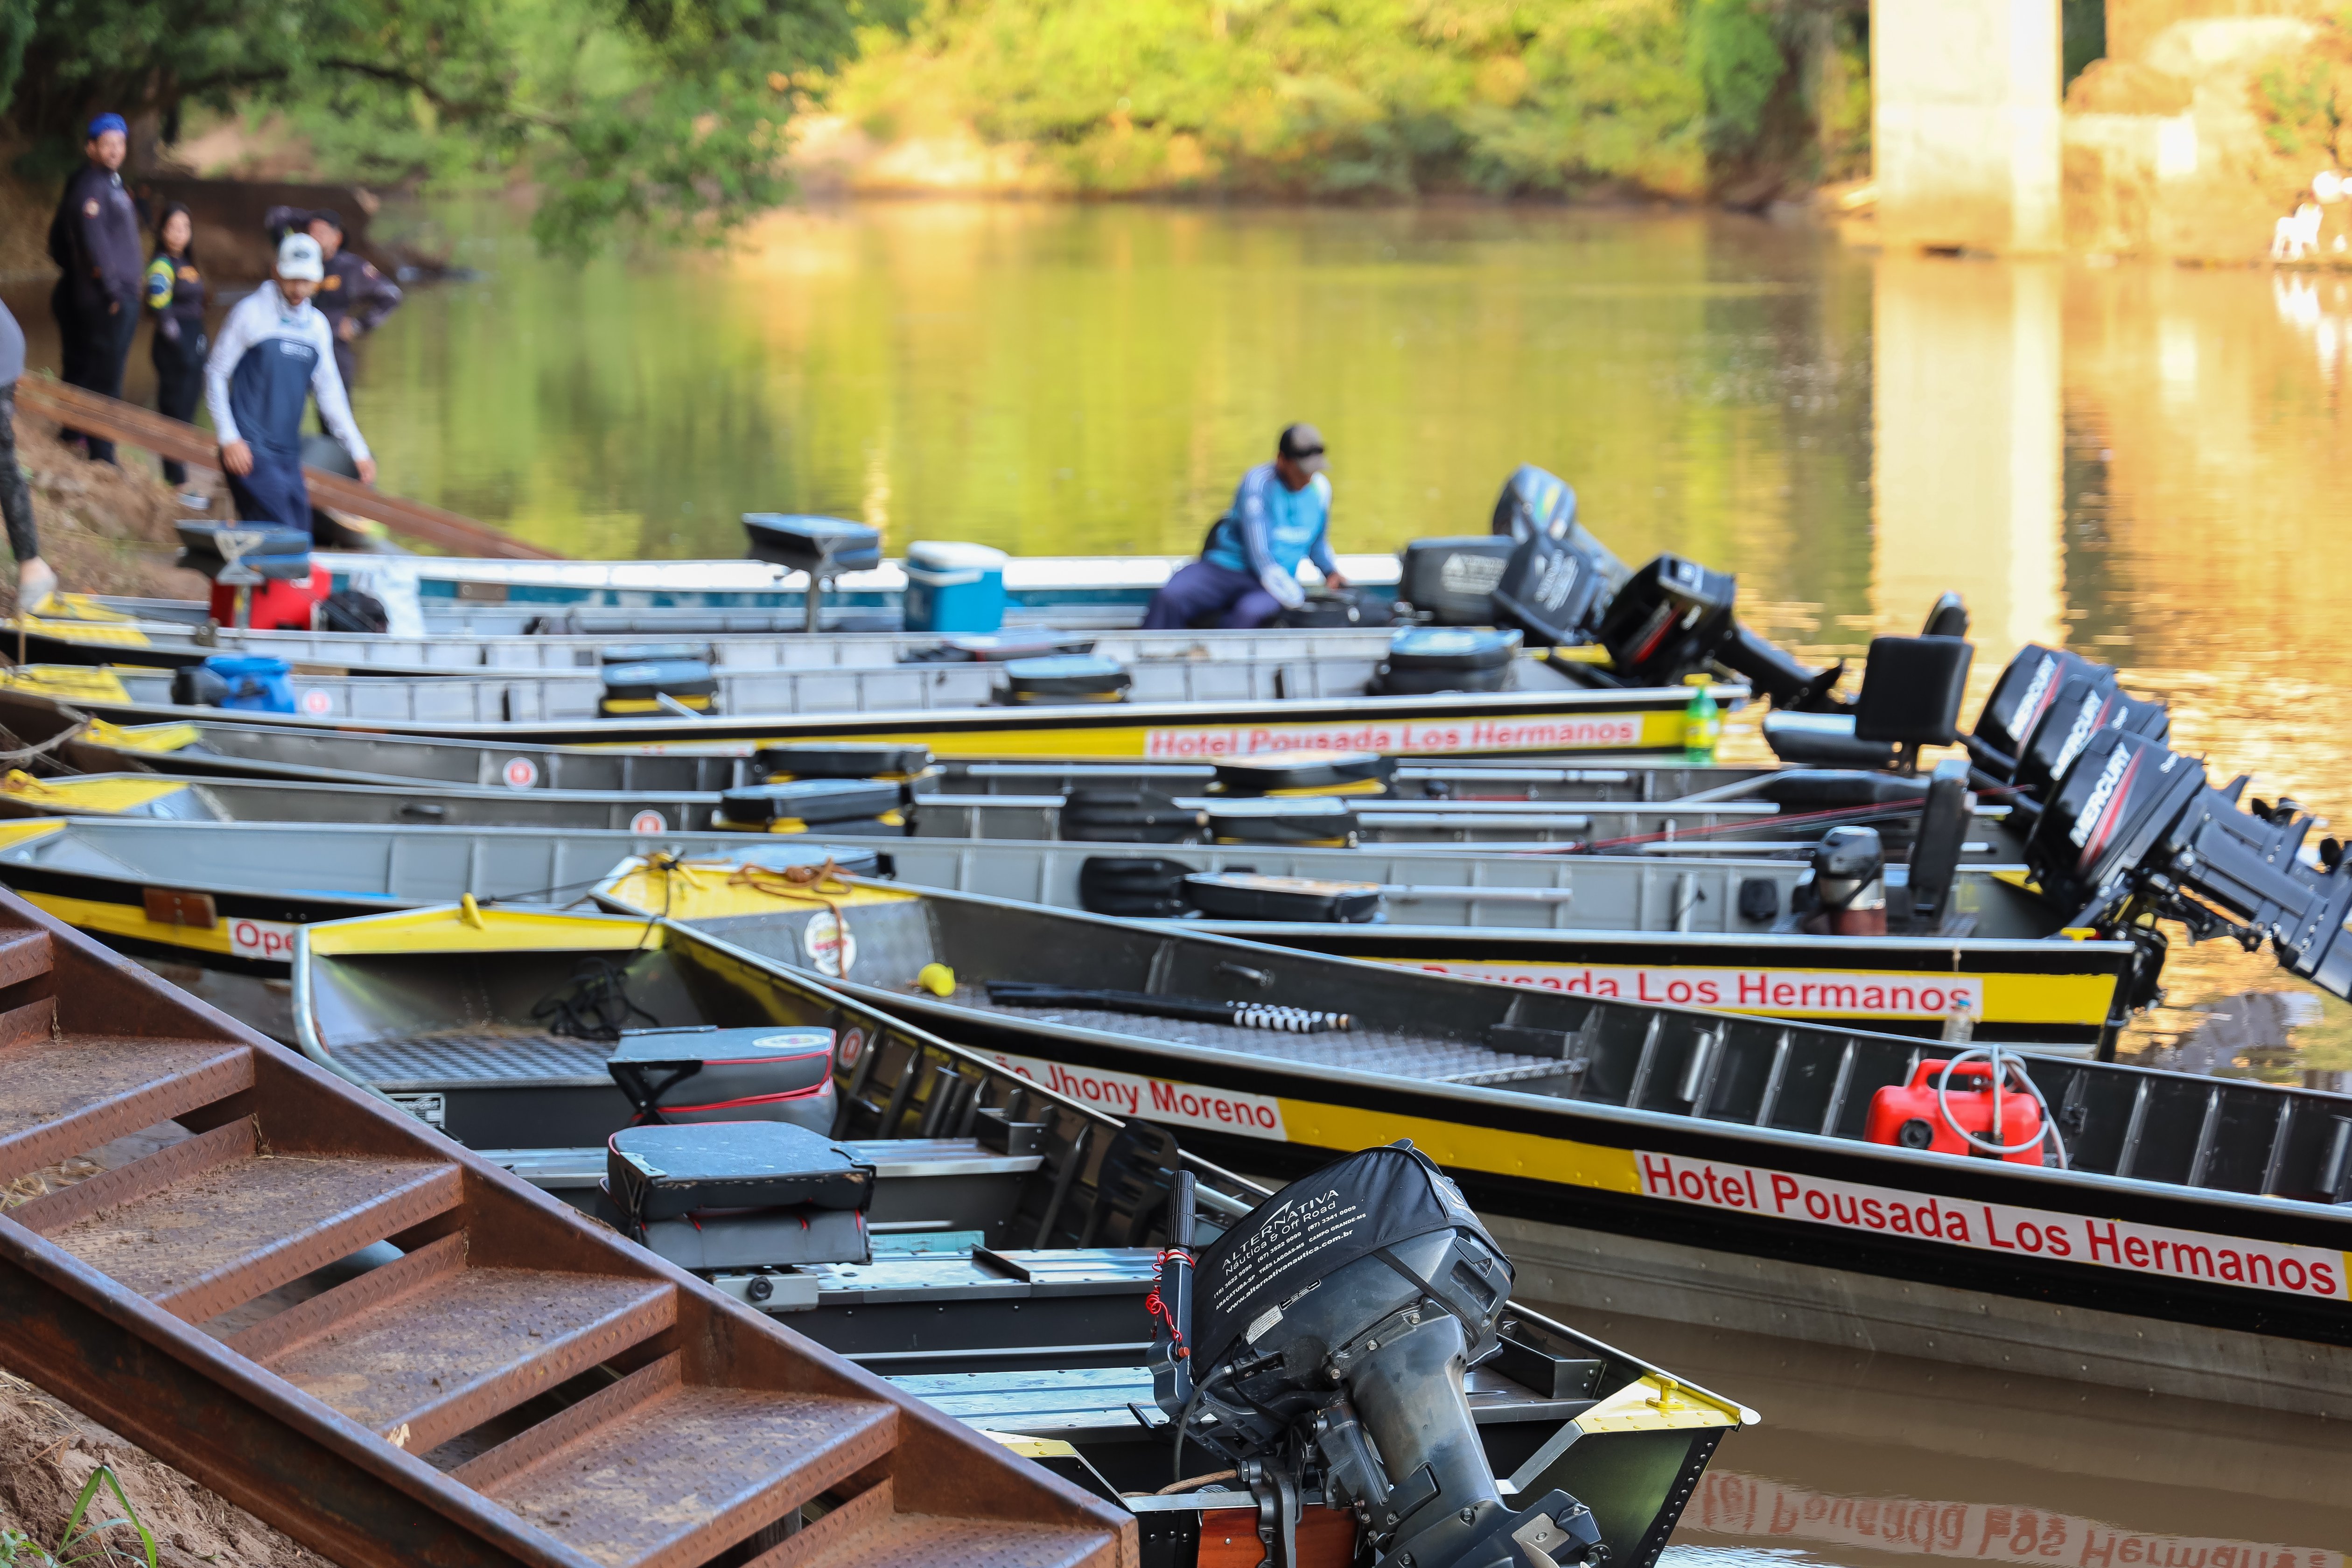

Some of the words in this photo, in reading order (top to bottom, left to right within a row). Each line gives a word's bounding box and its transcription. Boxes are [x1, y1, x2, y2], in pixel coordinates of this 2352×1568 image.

[1152, 730, 1238, 756] Hotel
[1250, 725, 1390, 752] Pousada
[1402, 724, 1460, 751] Los
[1473, 721, 1633, 747] Hermanos
[2069, 742, 2131, 848] MERCURY
[1638, 972, 1719, 1004] Los
[1738, 973, 1972, 1011] Hermanos
[1045, 1064, 1139, 1114] Jhony
[1149, 1080, 1275, 1129] Moreno
[1214, 1287, 1224, 1298] (18)
[1225, 1275, 1238, 1288] 3622
[1239, 1264, 1252, 1277] 9090
[1257, 1252, 1269, 1263] (67)
[1270, 1241, 1285, 1253] 3522
[1286, 1232, 1302, 1243] 9099
[1308, 1221, 1320, 1232] (67)
[1322, 1213, 1337, 1224] 3341
[1339, 1205, 1357, 1215] 0009
[1216, 1274, 1255, 1310] ARAÇATUBA-SP
[1259, 1262, 1273, 1274] TRÊS
[1273, 1242, 1305, 1264] LAGOAS-MS
[1309, 1229, 1330, 1242] CAMPO
[1330, 1213, 1366, 1231] GRANDE-MS
[1222, 1190, 1339, 1269] ALTERNATIVA
[1225, 1240, 1267, 1276] Náutica
[1270, 1233, 1278, 1242] &
[1281, 1218, 1299, 1234] Off
[1303, 1201, 1336, 1222] Road
[1643, 1155, 1758, 1209] Hotel
[1771, 1174, 1971, 1242] Pousada
[1983, 1206, 2071, 1256] Los
[2086, 1220, 2336, 1295] Hermanos
[1226, 1229, 1353, 1314] www.alternativanautica.com.br
